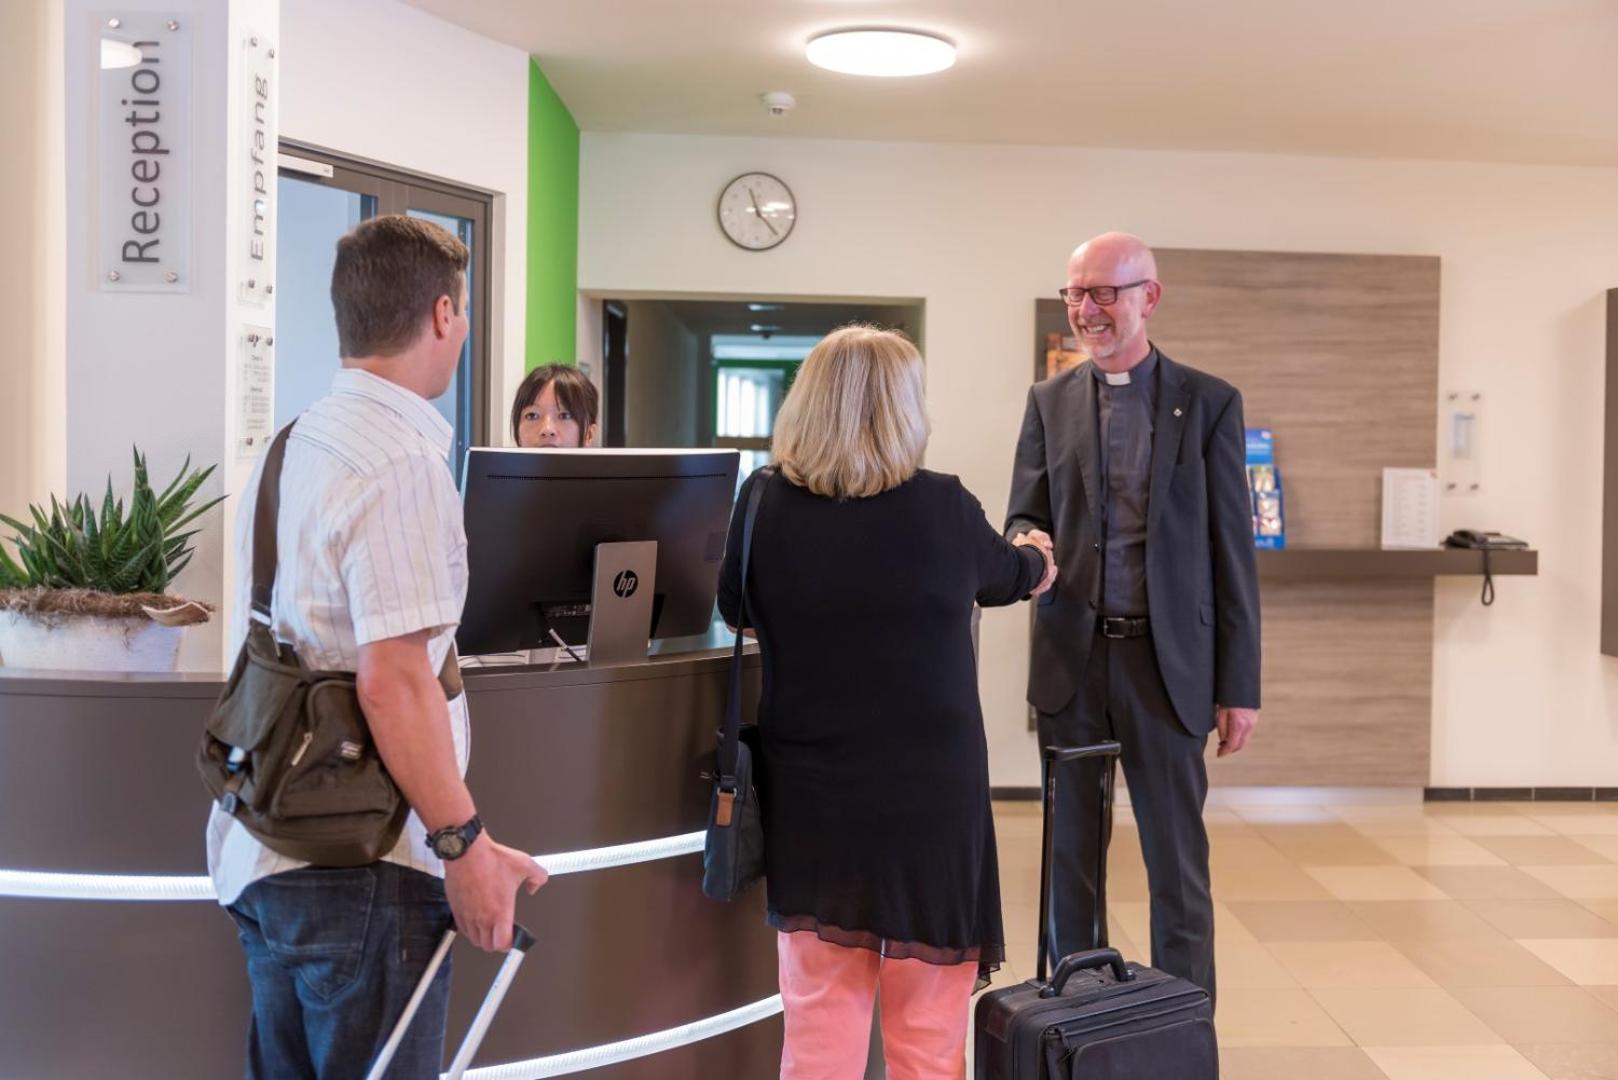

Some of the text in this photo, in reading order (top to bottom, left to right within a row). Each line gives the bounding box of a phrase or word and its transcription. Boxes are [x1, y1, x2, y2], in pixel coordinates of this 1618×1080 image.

[121, 40, 170, 263] Reception
[250, 76, 268, 261] Empfang
[615, 570, 636, 598] hp
